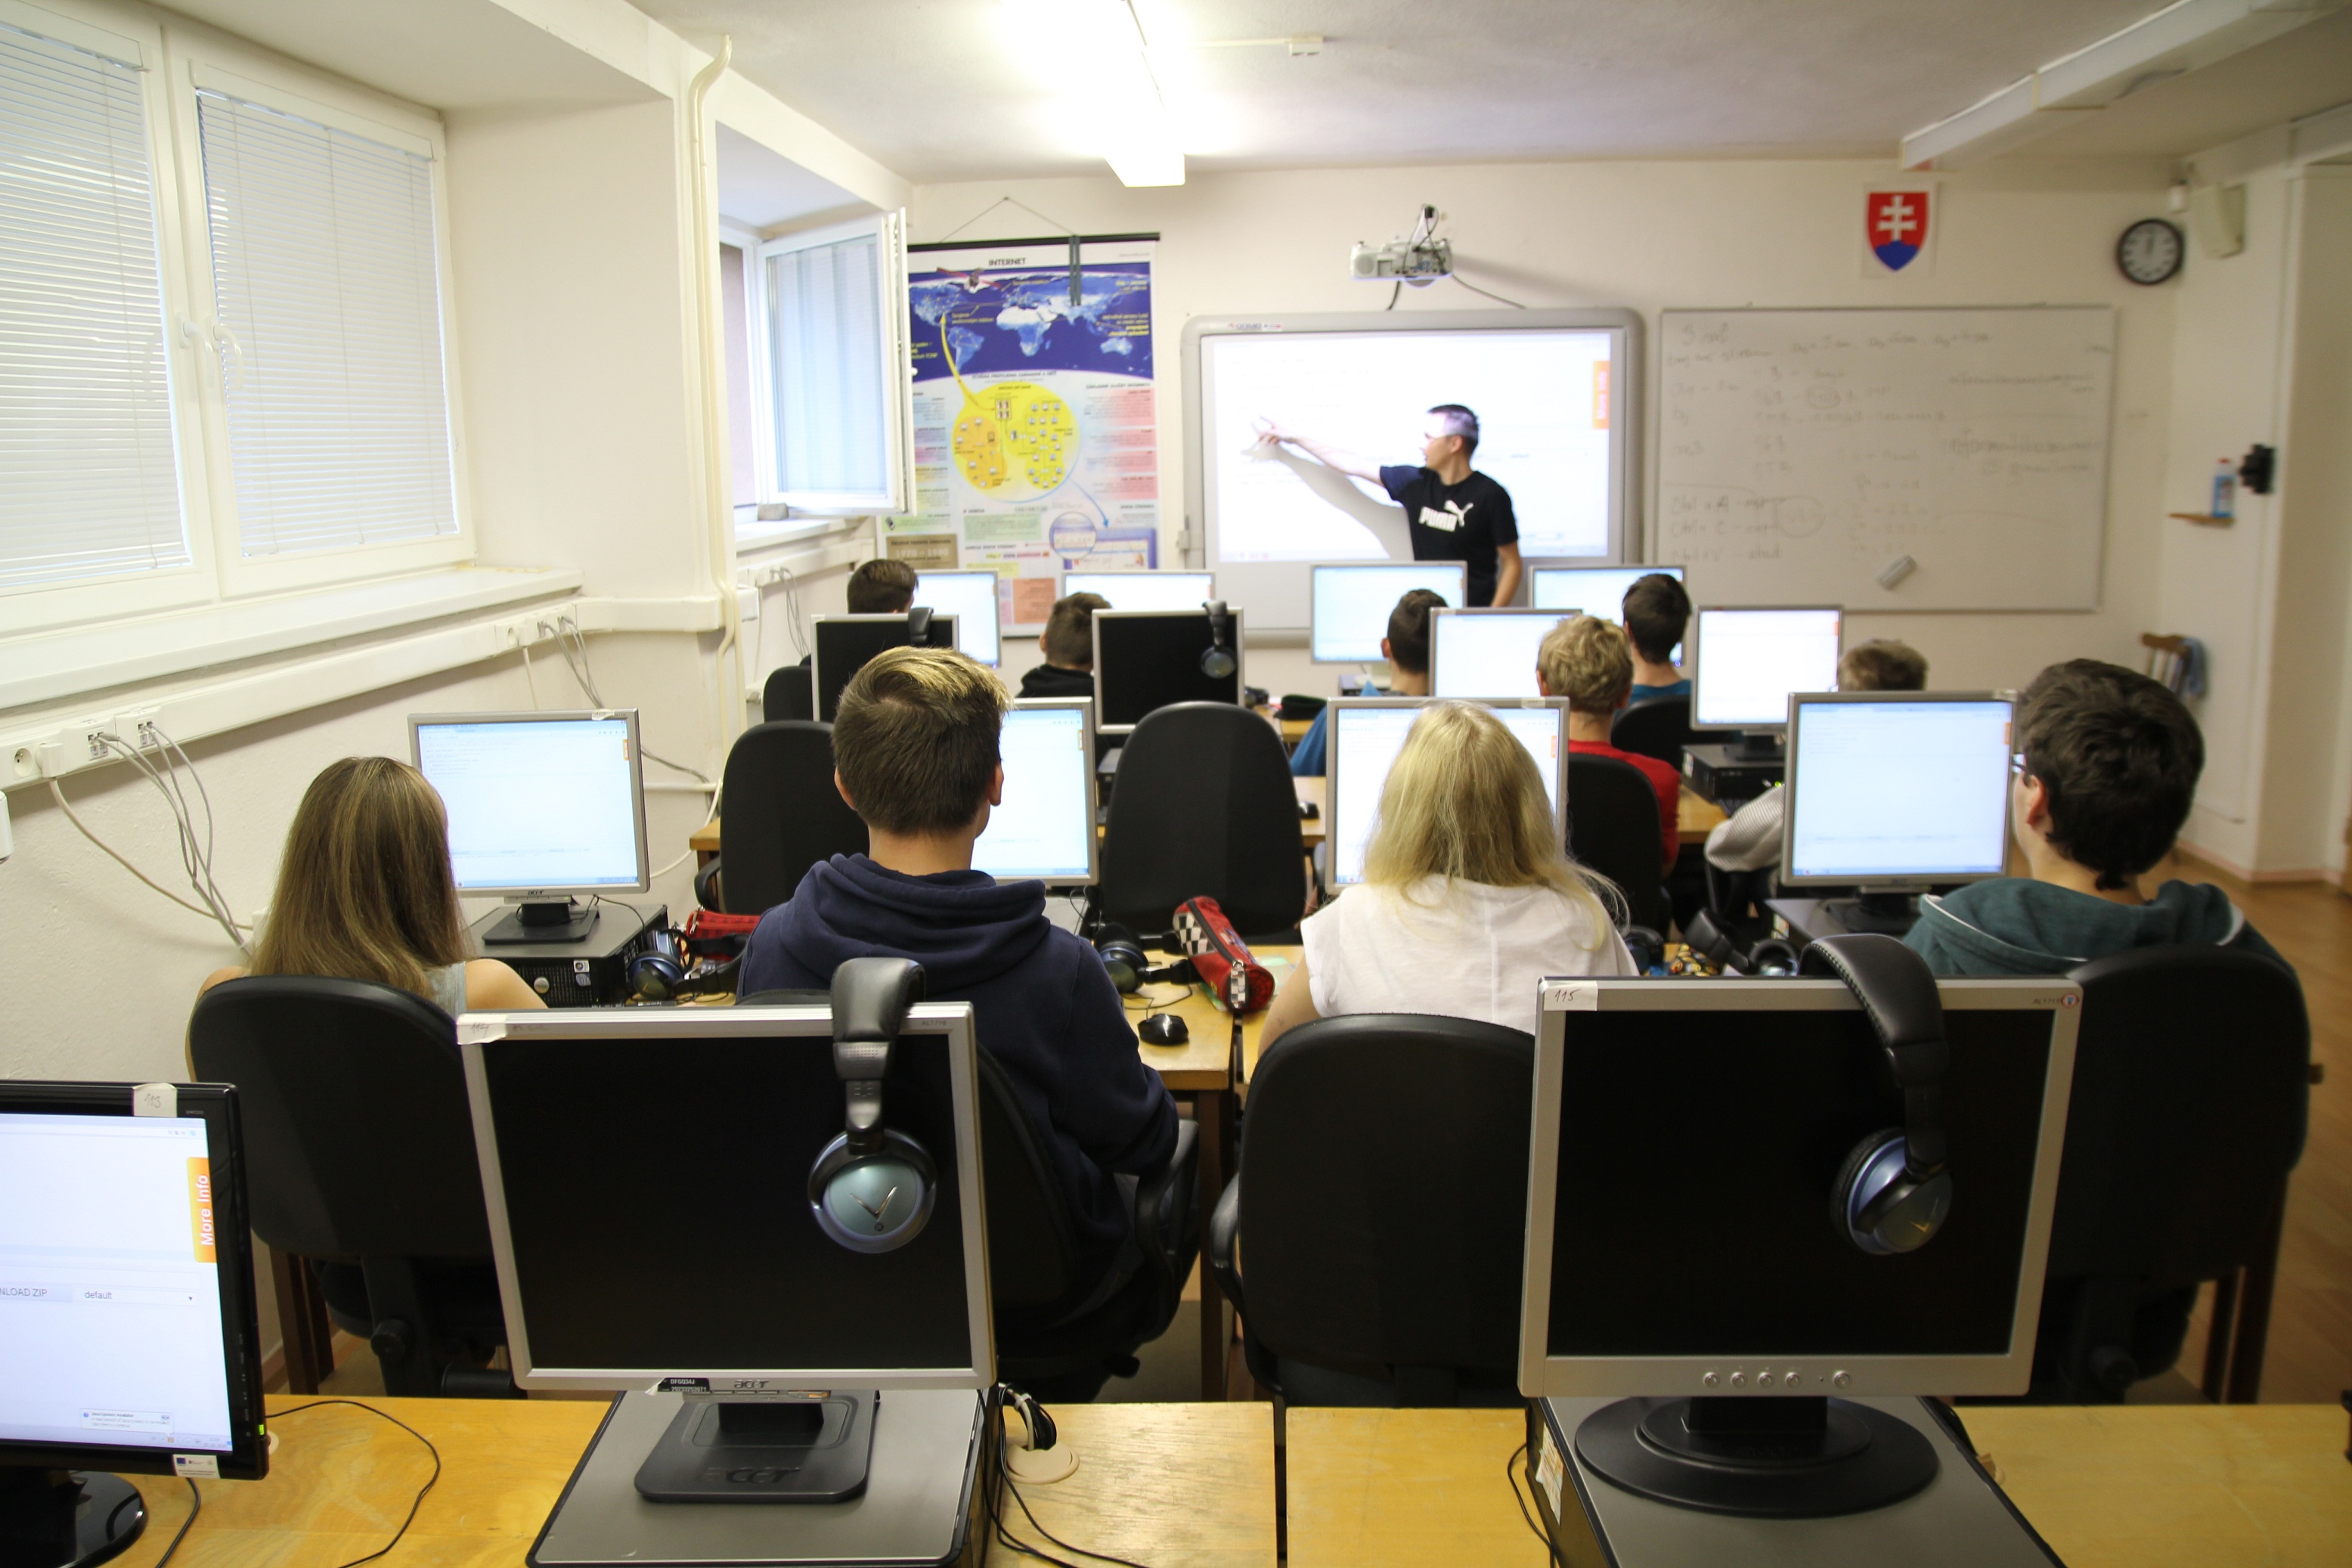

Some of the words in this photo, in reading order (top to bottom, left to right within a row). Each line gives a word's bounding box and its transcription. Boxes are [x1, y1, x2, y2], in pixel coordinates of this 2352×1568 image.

[988, 257, 1026, 266] INTERNET
[1418, 506, 1458, 532] PUMA
[1554, 989, 1582, 1003] 115
[196, 1174, 211, 1203] Info
[200, 1207, 214, 1247] More
[33, 1288, 48, 1297] ZIP
[85, 1291, 113, 1300] default
[733, 1379, 769, 1390] acer
